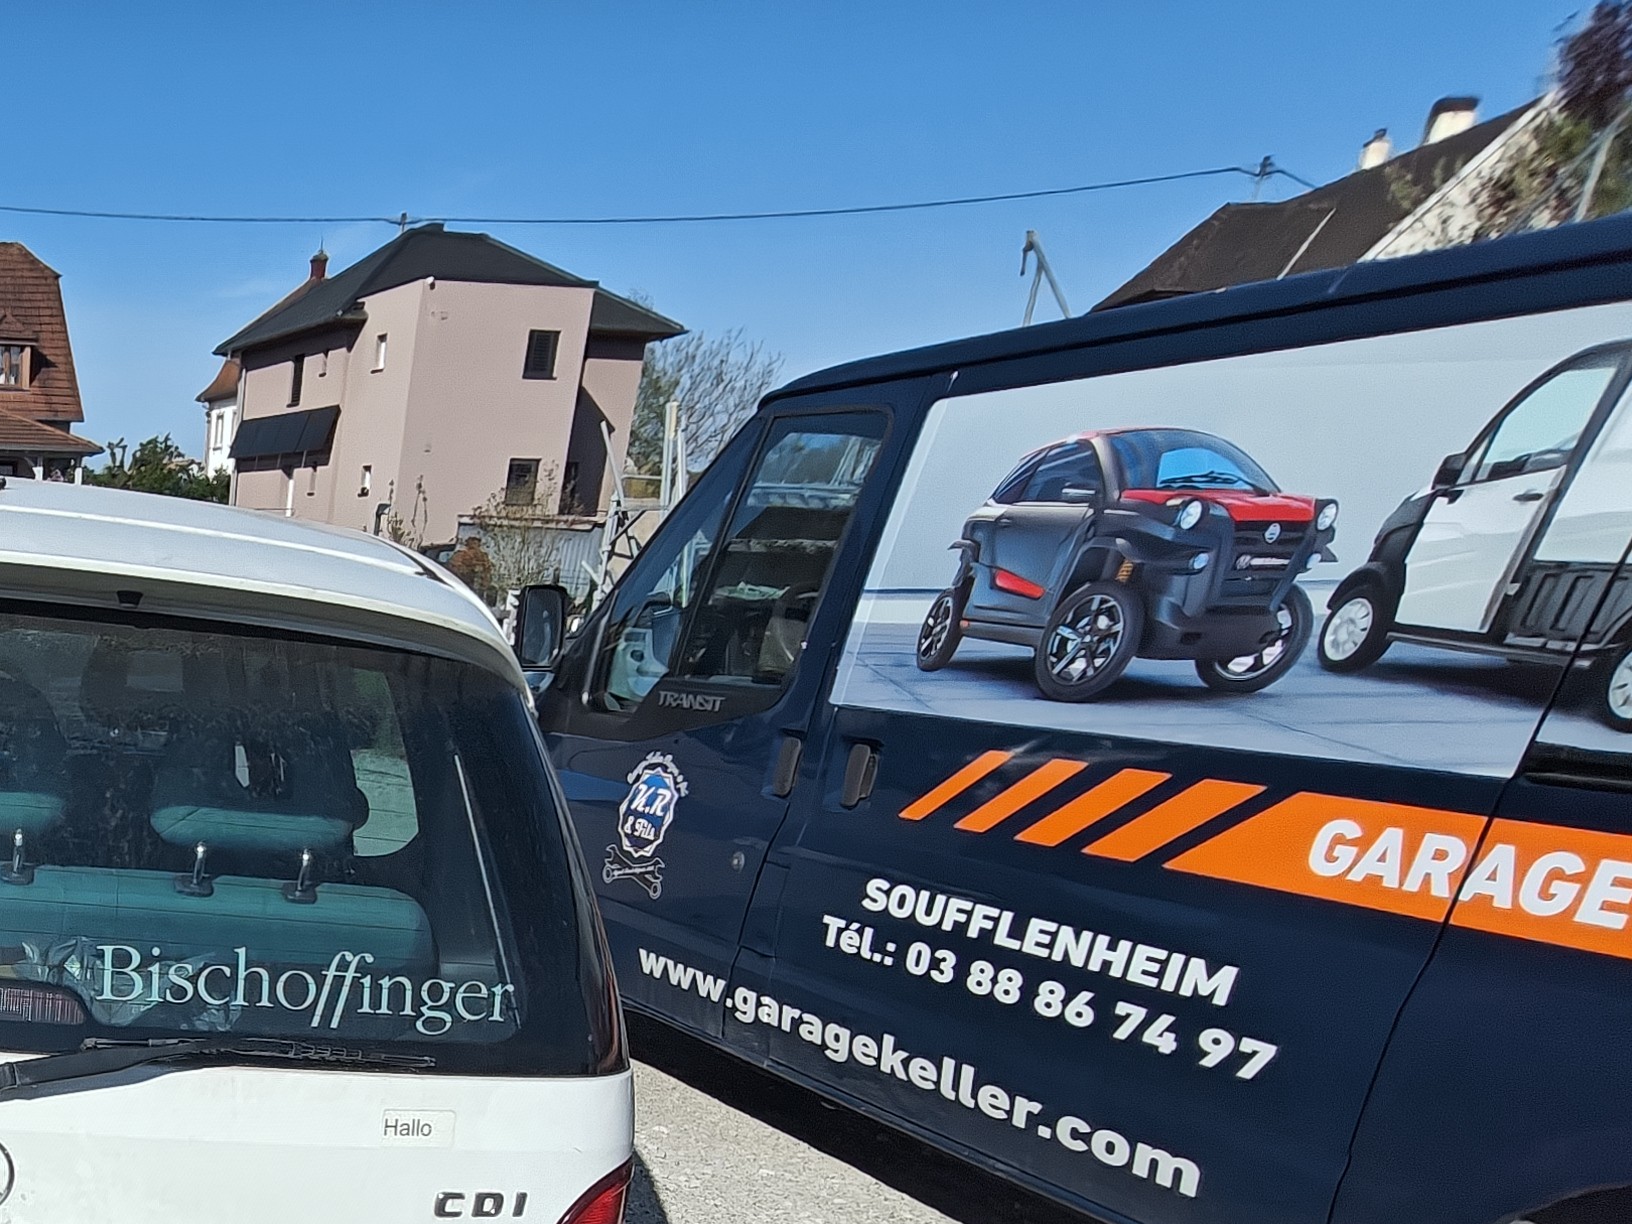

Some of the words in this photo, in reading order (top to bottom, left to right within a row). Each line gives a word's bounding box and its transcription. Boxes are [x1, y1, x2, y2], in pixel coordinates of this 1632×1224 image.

[657, 690, 726, 712] TRANSIT
[1308, 818, 1632, 930] GARAGE
[95, 945, 515, 1035] Bischoffinger
[861, 878, 1239, 1006] SOUFFLENHEIM
[822, 914, 897, 966] Tél.:
[905, 941, 957, 984] 03
[966, 960, 1023, 1004] 88
[1033, 980, 1095, 1028] 86
[1112, 1001, 1178, 1055] 74
[1198, 1028, 1278, 1080] 97
[638, 948, 1201, 1198] www.garagekeller.com
[383, 1117, 433, 1138] Hallo
[434, 1191, 529, 1218] CDI
